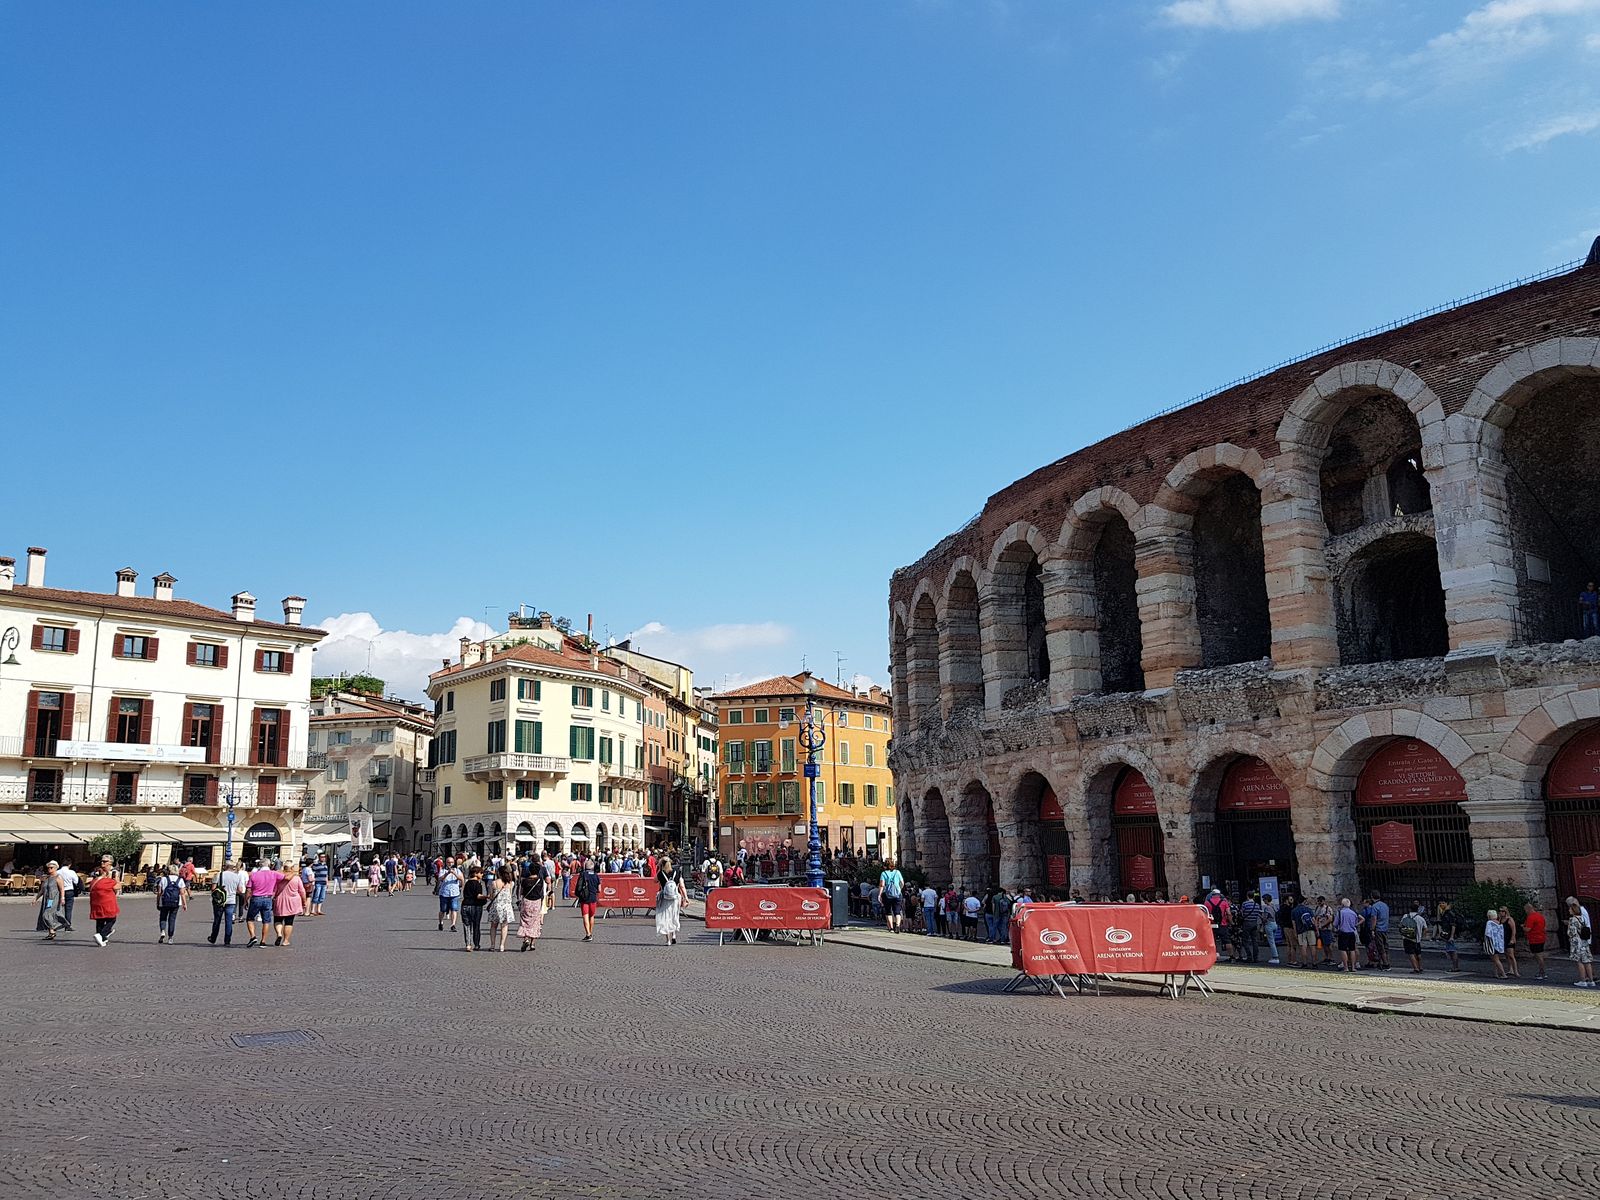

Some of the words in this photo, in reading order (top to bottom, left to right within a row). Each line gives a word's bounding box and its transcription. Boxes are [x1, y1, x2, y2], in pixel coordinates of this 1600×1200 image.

[1407, 771, 1436, 779] SETTORE
[1378, 777, 1419, 786] GRADINATA
[1419, 775, 1458, 783] NUMERATA
[1241, 784, 1265, 792] ARENA
